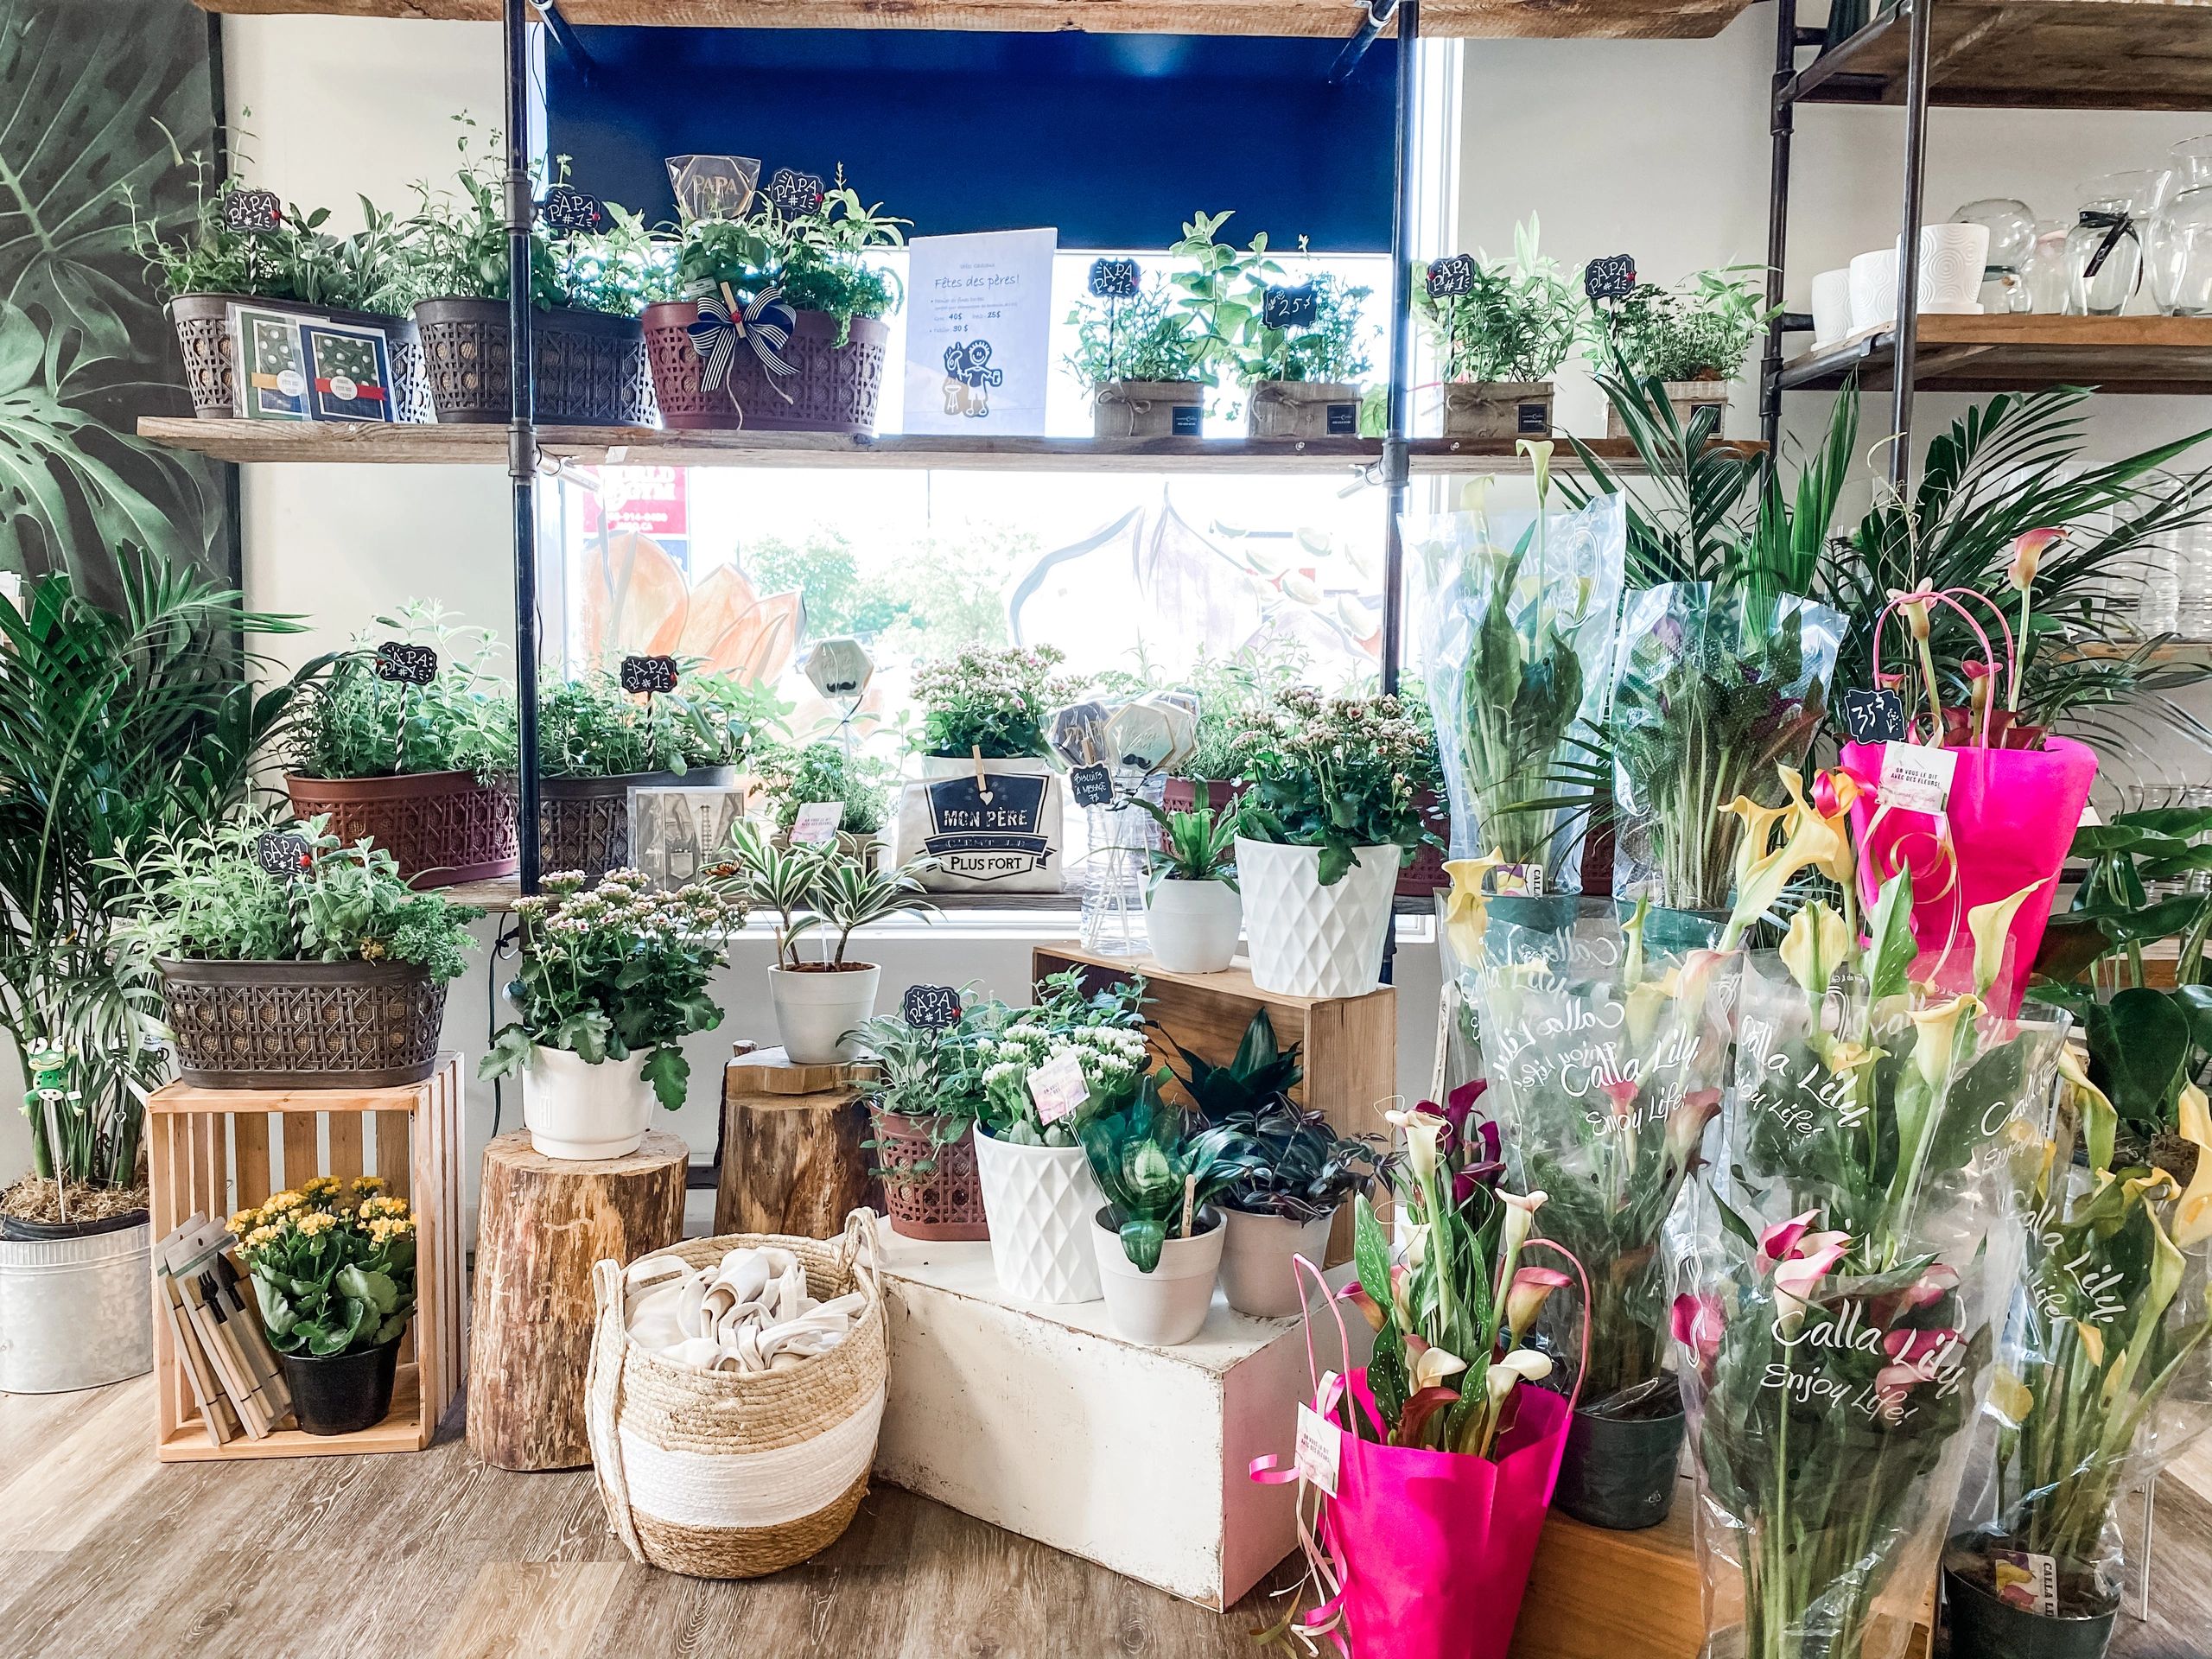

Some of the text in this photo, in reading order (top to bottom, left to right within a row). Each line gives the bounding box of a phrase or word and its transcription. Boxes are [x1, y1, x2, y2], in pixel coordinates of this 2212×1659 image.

[692, 175, 741, 195] PAPA
[775, 175, 817, 202] PAPA
[229, 196, 274, 225] PAPA
[548, 195, 593, 222] PAPA
[787, 195, 807, 209] #1
[244, 213, 263, 226] #1
[563, 213, 585, 226] #1
[935, 274, 1020, 290] Fêtes des pères!
[1092, 263, 1133, 294] PAPA
[1107, 281, 1122, 294] #1
[1433, 260, 1470, 292] PAPA
[1444, 275, 1464, 292] #1
[1589, 261, 1627, 295] PAPA
[1604, 277, 1621, 291] #1
[1279, 295, 1312, 316] 25$
[626, 659, 670, 690] PAPA
[641, 674, 662, 689] #1
[944, 807, 1027, 827] MON PÈRE
[263, 838, 302, 868] PAPA
[278, 856, 295, 870] #1
[950, 856, 1022, 870] PLUS FORT
[910, 992, 952, 1023] PAPA
[925, 1007, 945, 1022] #1
[1742, 1014, 1790, 1077] Calla
[1560, 1043, 1643, 1097] Calla
[1586, 1081, 1690, 1142] Enjoy Life!
[1771, 1299, 1883, 1356] Calla
[1760, 1363, 1919, 1427] Enjoy Life!
[2044, 1562, 2053, 1599] CALLA
